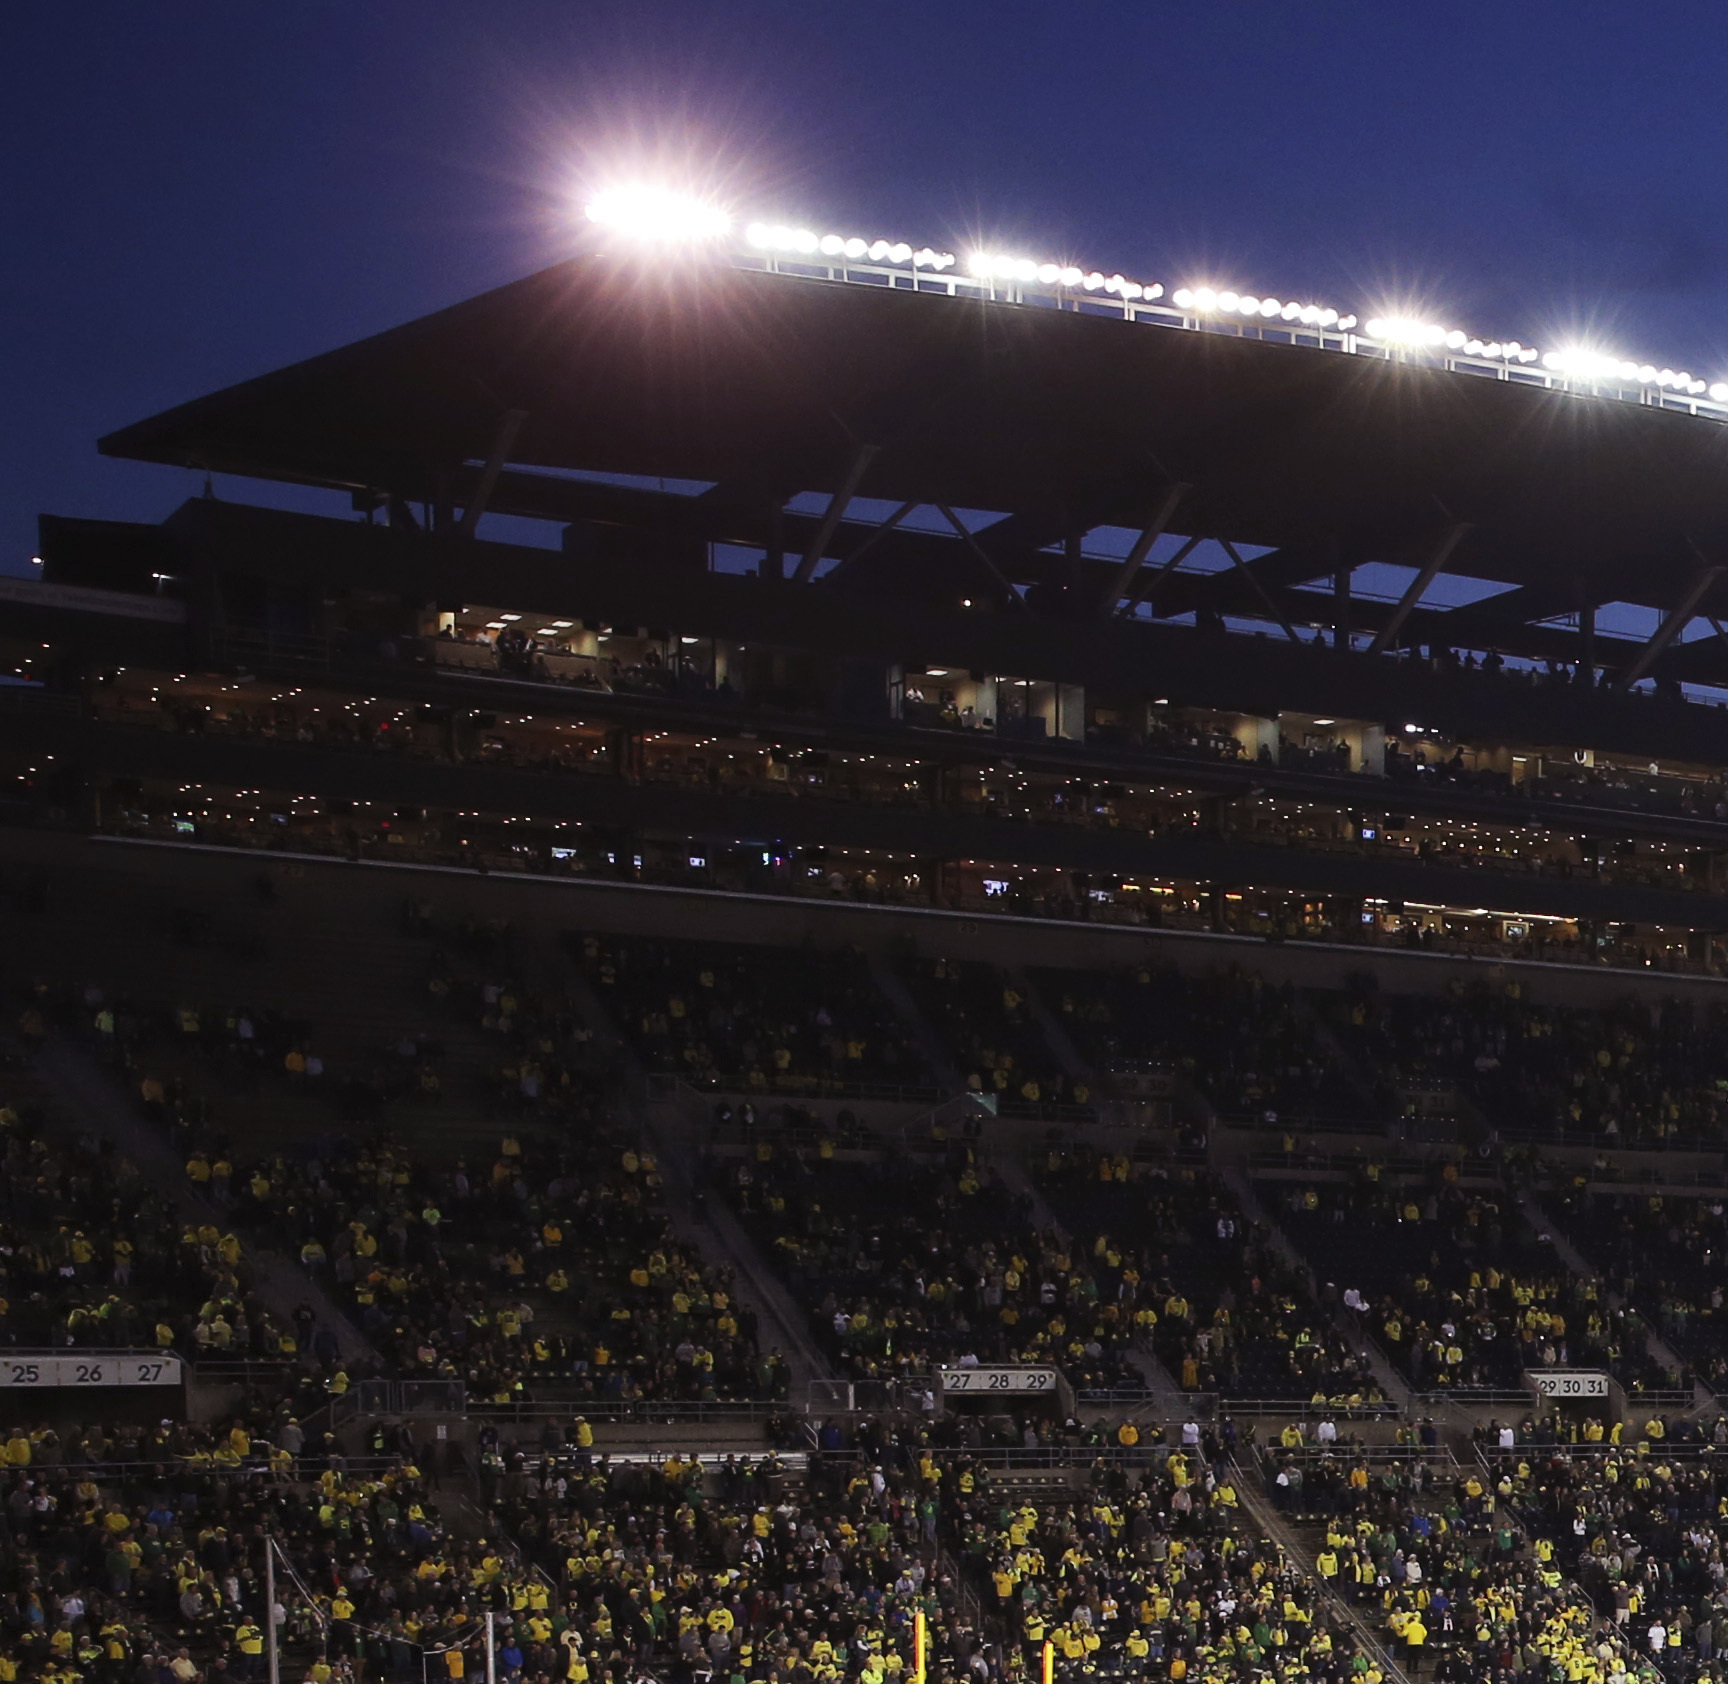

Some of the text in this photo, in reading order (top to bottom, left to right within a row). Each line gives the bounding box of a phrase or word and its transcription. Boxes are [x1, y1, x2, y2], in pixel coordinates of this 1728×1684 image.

[11, 1364, 162, 1384] 25 26 27
[951, 1374, 1046, 1388] 27 28 29
[1541, 1380, 1603, 1394] 29 30 31
